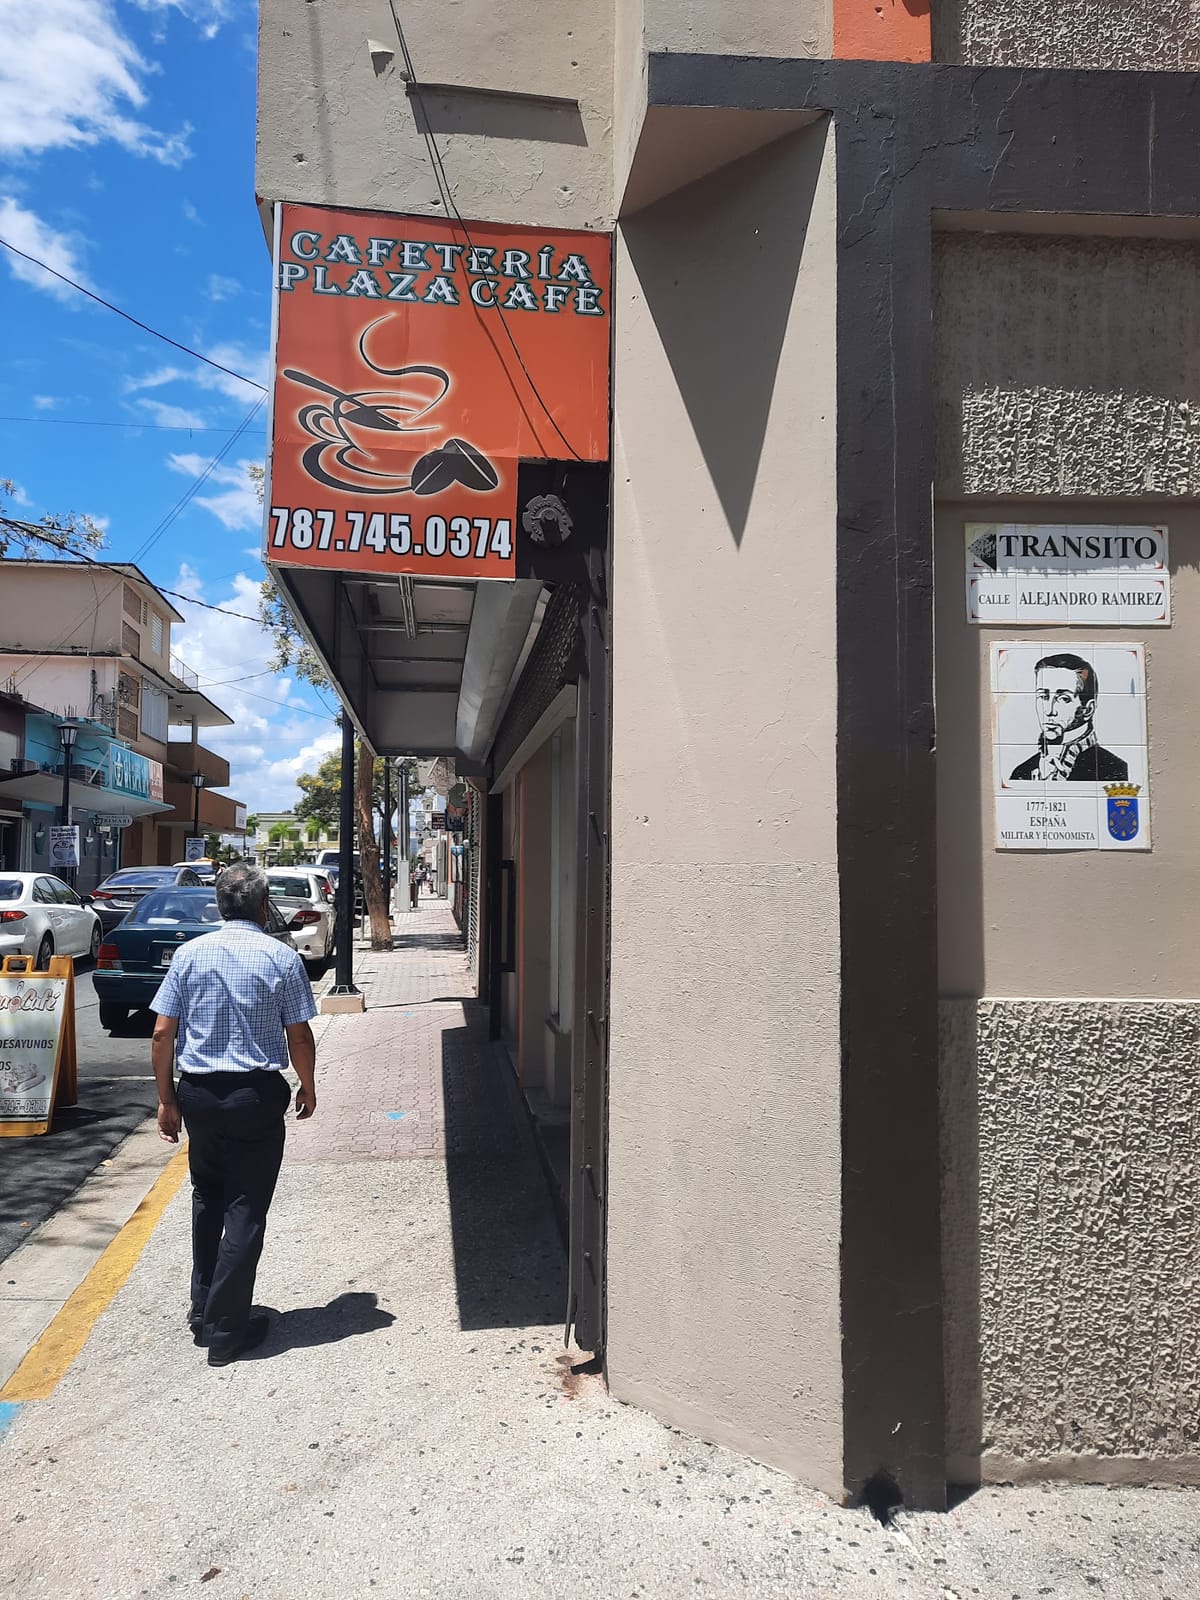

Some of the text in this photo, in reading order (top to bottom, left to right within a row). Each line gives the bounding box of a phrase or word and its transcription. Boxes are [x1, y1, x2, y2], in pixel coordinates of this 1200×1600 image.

[290, 230, 592, 283] CAFETERÍA
[279, 262, 605, 315] PLAZA CAFÉ
[270, 506, 513, 559] 787.745.0374
[999, 534, 1157, 559] TRANSITO
[978, 591, 1163, 606] CALLE ALEJANDRO RAMIREZ
[1026, 801, 1067, 812] 1777-1821
[1030, 814, 1067, 827] ESPAÑA
[1000, 831, 1096, 841] MILITAR Y ECONOMISTA
